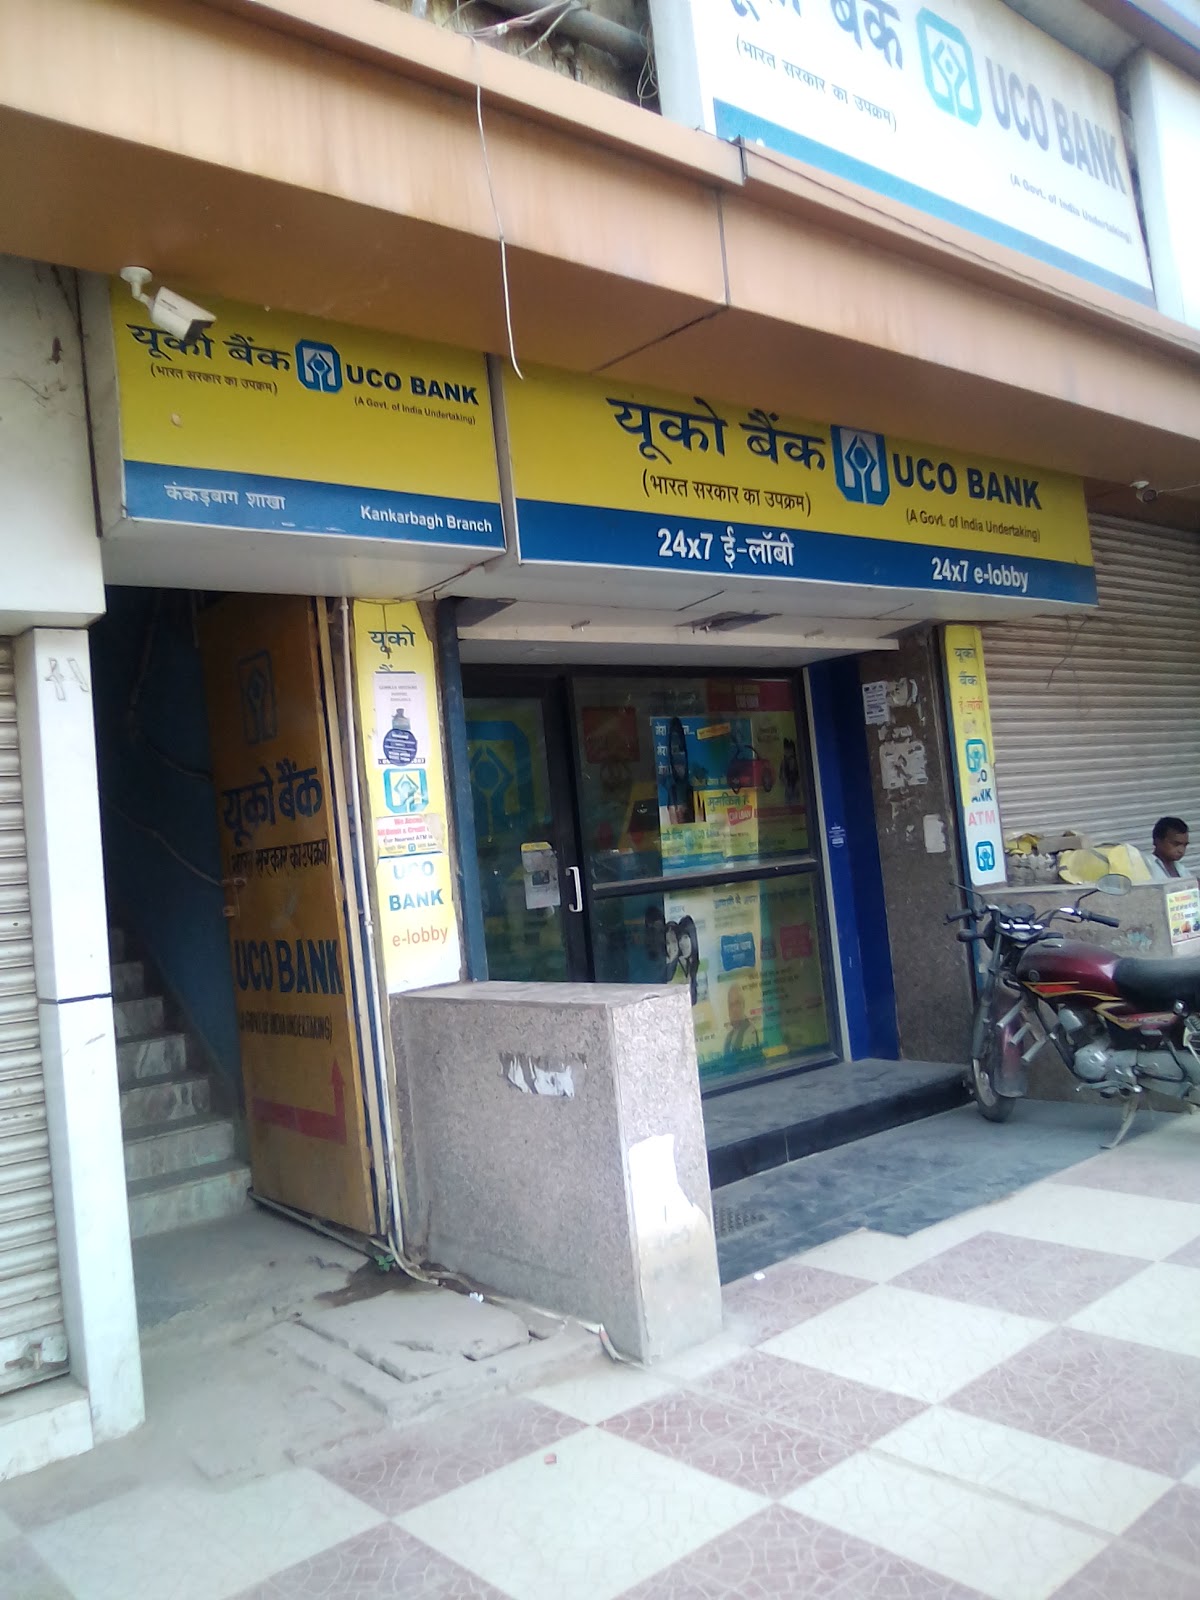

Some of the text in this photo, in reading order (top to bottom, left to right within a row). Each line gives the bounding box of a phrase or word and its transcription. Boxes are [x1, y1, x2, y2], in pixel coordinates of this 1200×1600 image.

[782, 59, 826, 93] सरकार
[831, 83, 848, 104] का
[985, 56, 1128, 195] UCO BANK
[1048, 191, 1057, 206] of
[1059, 195, 1081, 217] India
[222, 334, 292, 372] बैंक
[186, 370, 222, 386] सरकार
[224, 375, 238, 388] का
[346, 363, 480, 406] UCO BANK
[354, 396, 476, 426] (A Govt. of India Undertaking)
[606, 397, 827, 472] यूको बैंक
[246, 490, 286, 511] शाखा
[642, 468, 812, 518] (भारत सरकार का उपक्रम)
[893, 453, 1044, 512] UCO BANK
[360, 504, 494, 534] Kankarbagh Branch
[905, 507, 1042, 544] (A Govt. of India Undertaking)
[657, 526, 796, 571] 24x7 ई-लॉबी
[931, 556, 1030, 595] 24x7 e-lobby
[368, 624, 416, 660] यूको
[222, 766, 276, 847] यूको
[968, 809, 995, 827] ATM
[389, 888, 444, 913] BANK
[392, 926, 450, 949] e-lobby
[235, 939, 345, 994] UCO BANK
